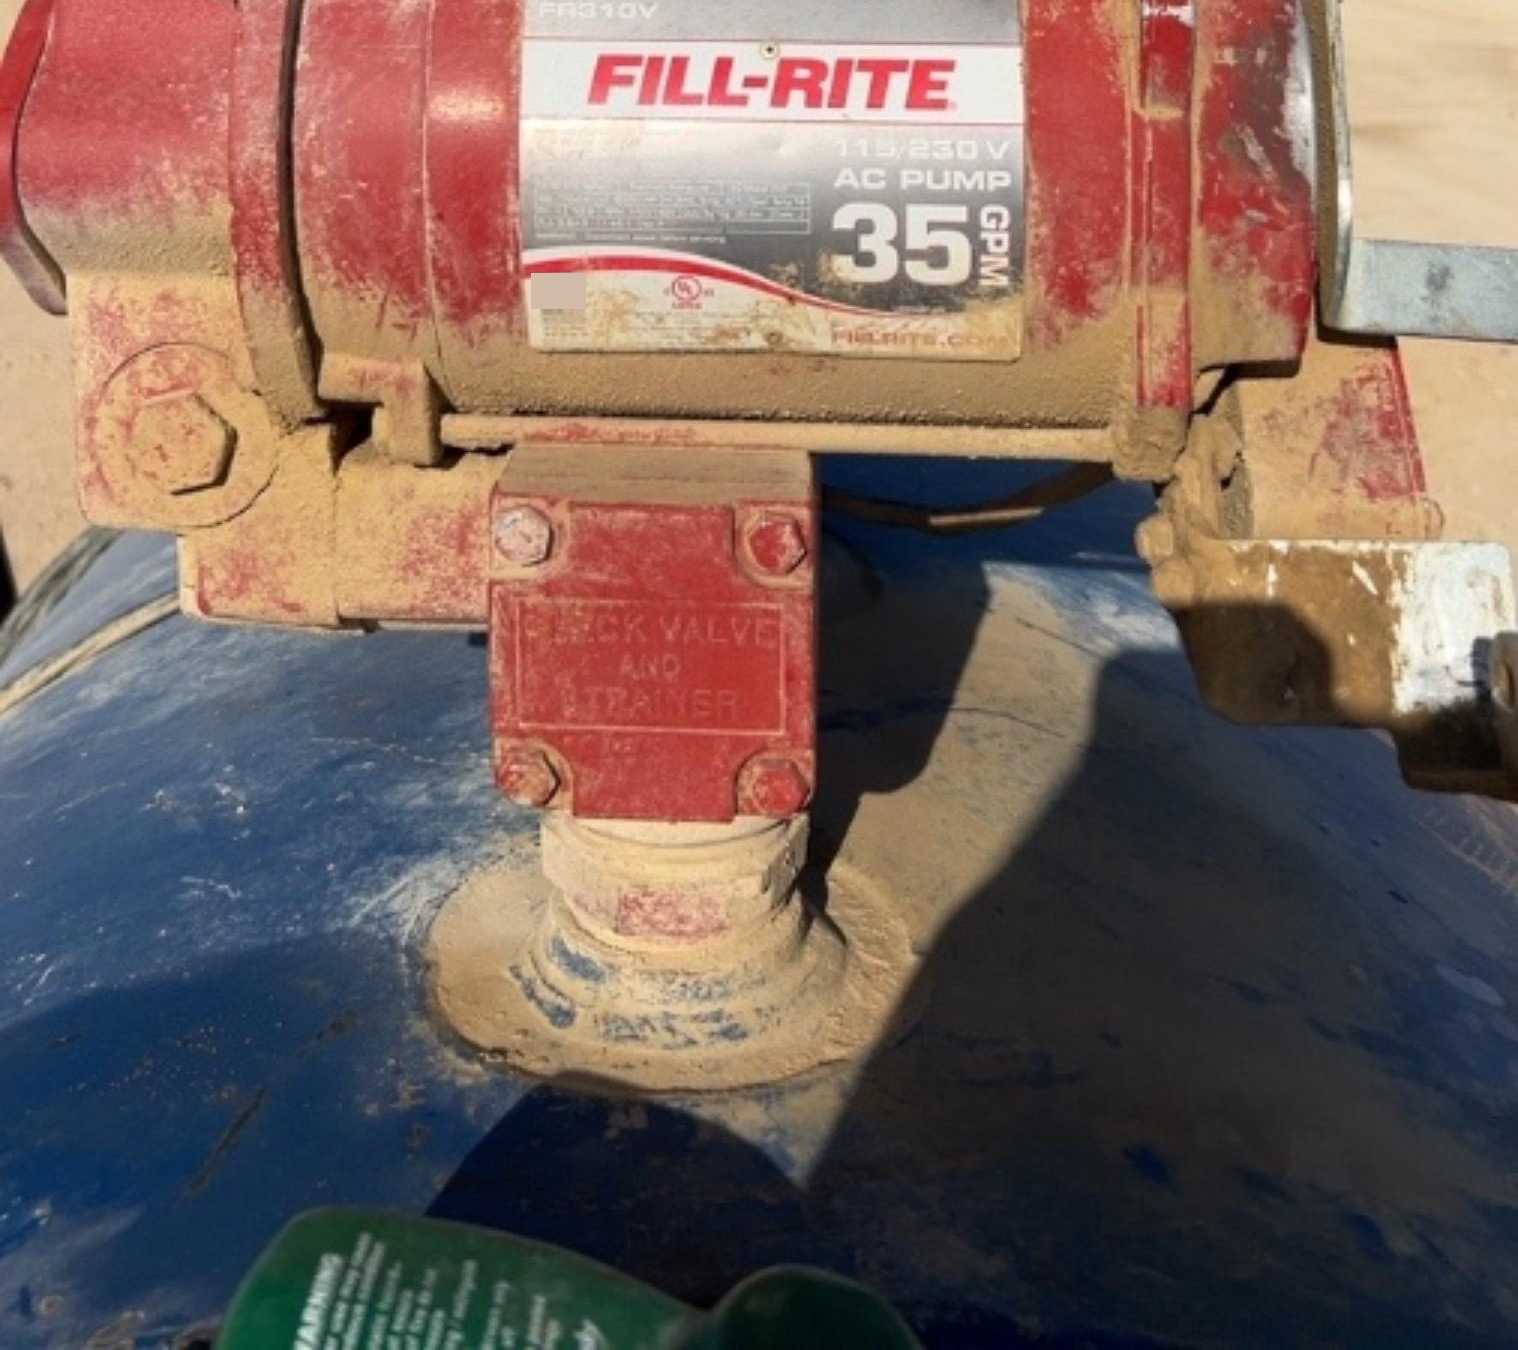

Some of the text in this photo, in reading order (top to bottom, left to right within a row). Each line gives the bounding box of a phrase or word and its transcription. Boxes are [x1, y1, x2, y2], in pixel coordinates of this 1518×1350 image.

[538, 2, 659, 19] FR310V
[588, 53, 956, 110] FILL-RITE
[985, 139, 1010, 161] V
[833, 168, 1012, 191] AC PUMP
[831, 203, 973, 286] 35
[979, 204, 1010, 286] GPM
[659, 614, 779, 649] VALVE
